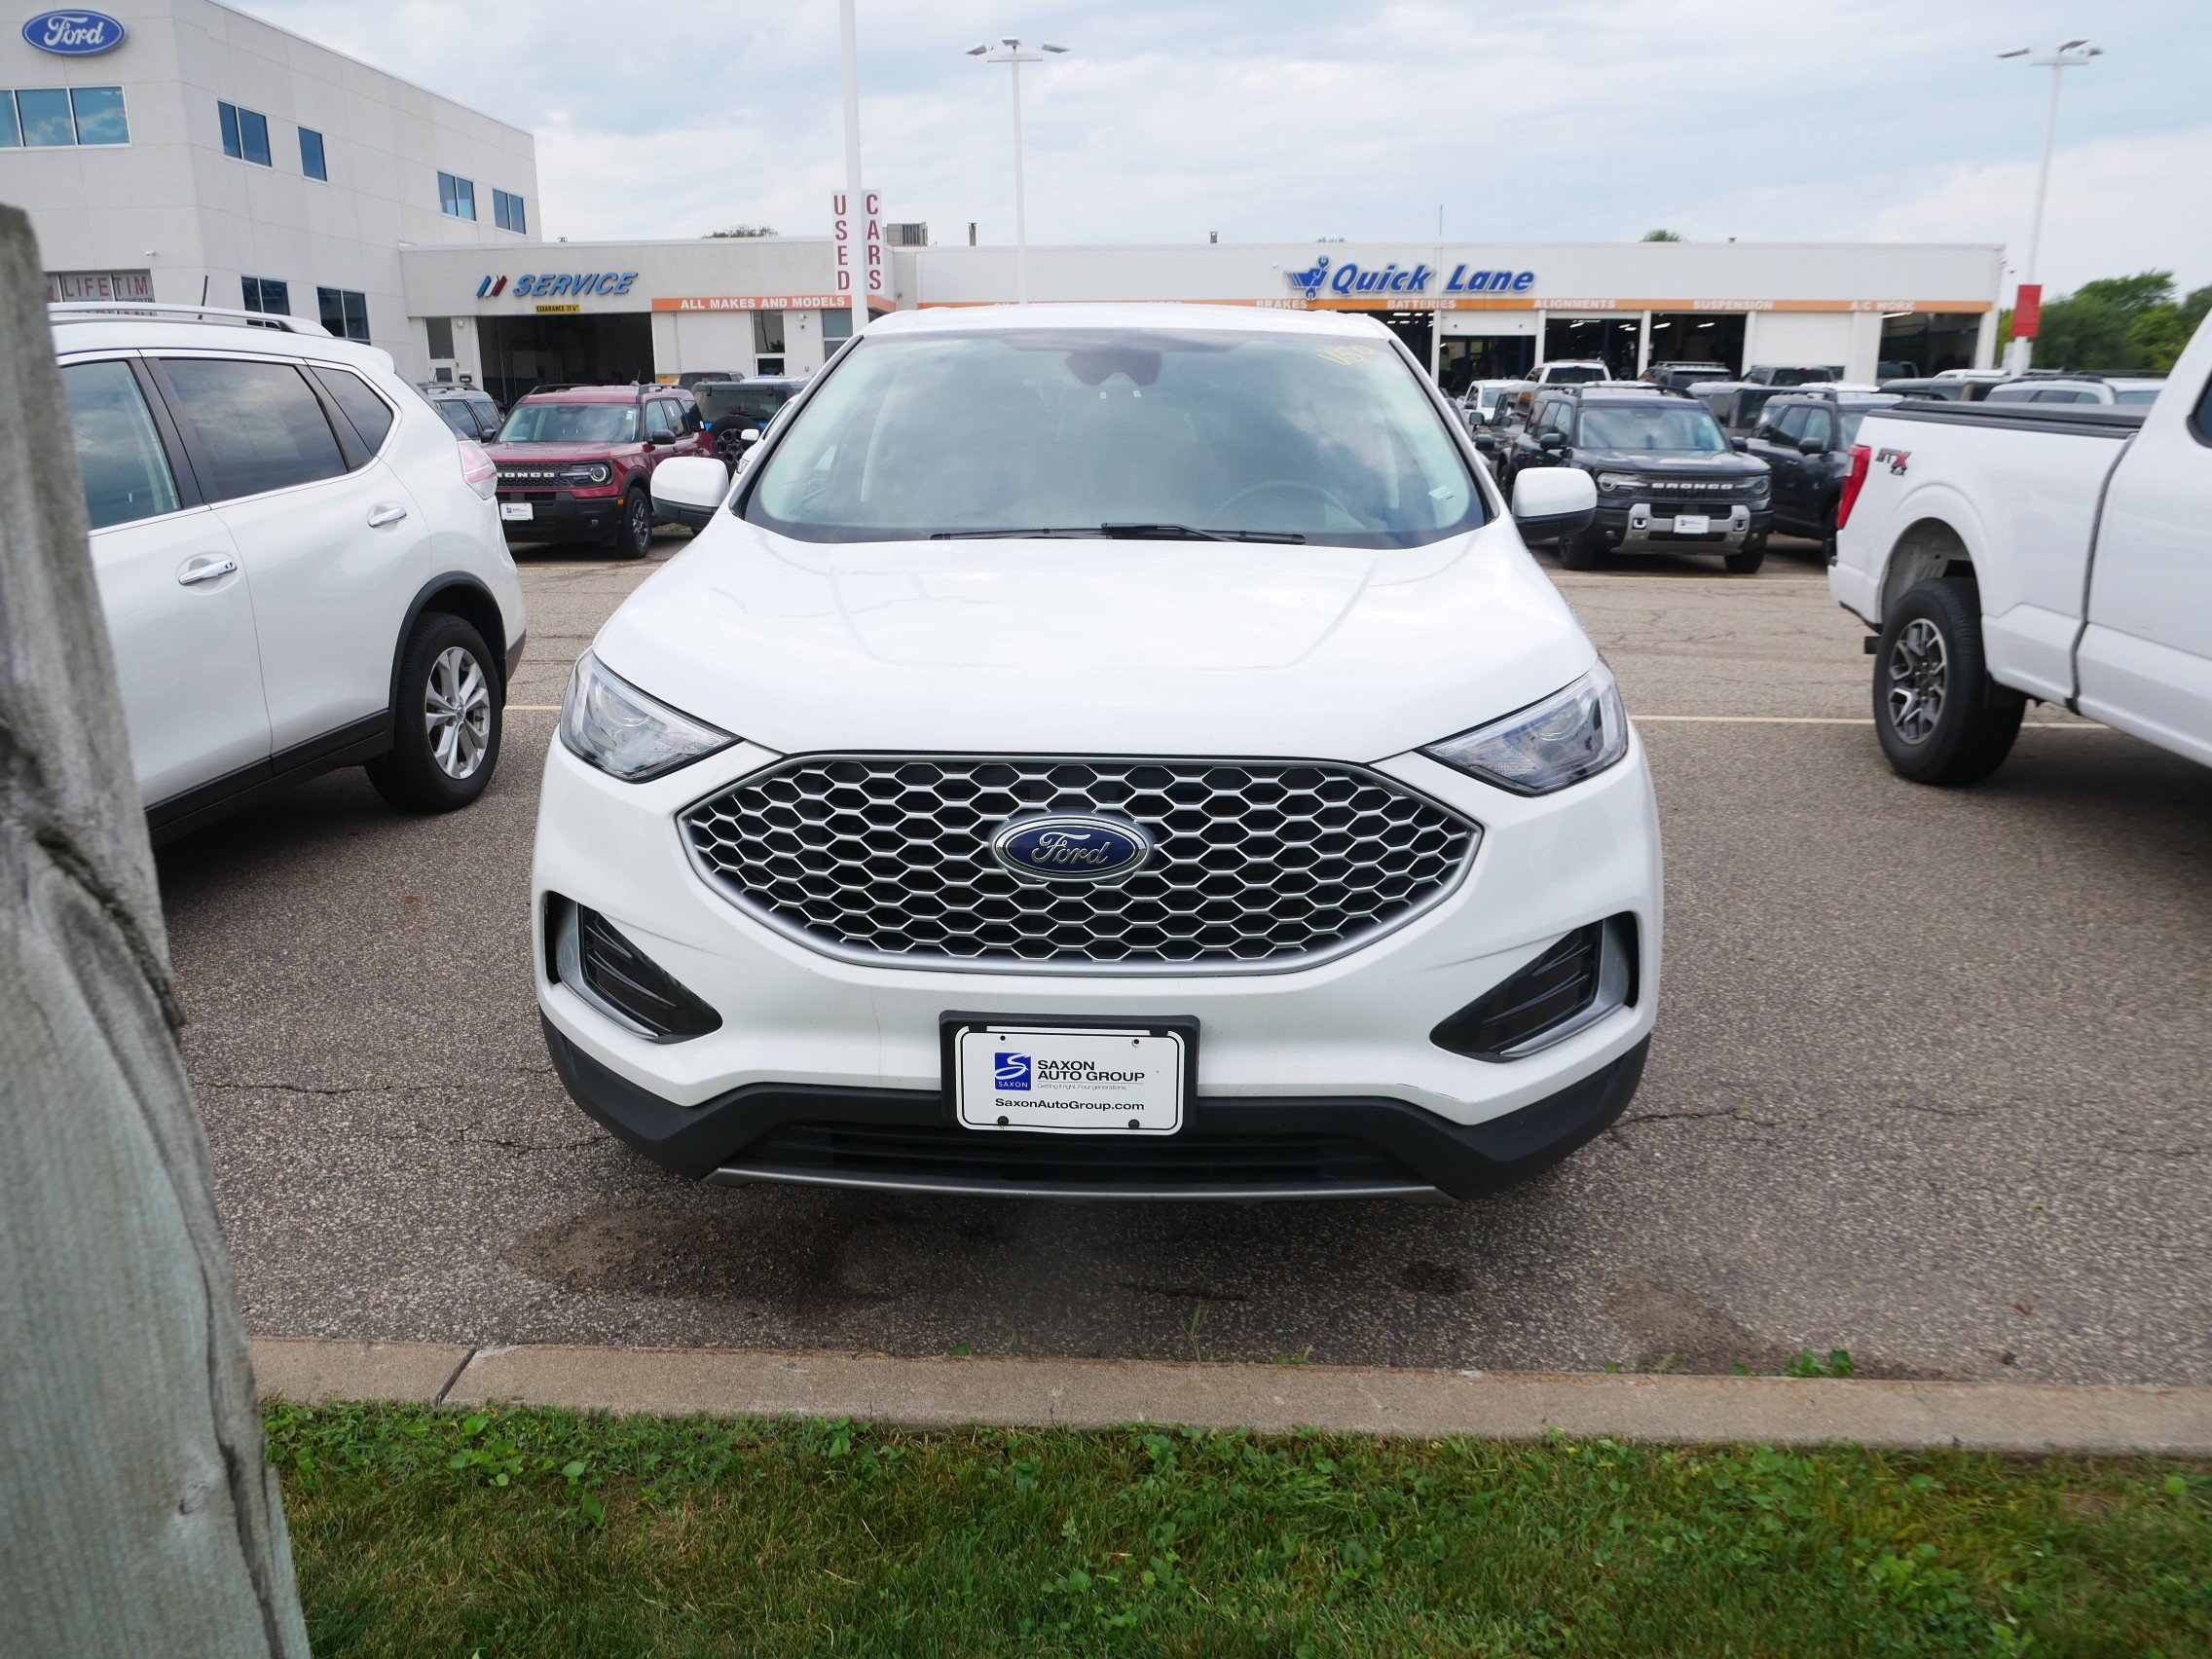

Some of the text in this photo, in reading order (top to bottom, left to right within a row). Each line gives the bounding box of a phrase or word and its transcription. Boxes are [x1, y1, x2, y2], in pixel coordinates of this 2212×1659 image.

[44, 16, 104, 47] Ford
[833, 194, 850, 291] USED
[866, 194, 882, 291] CARS
[513, 272, 639, 297] SERVICE
[1331, 263, 1536, 296] Quick Lane
[681, 296, 845, 310] ALL MAKES AND MODELS
[1256, 300, 1308, 309] BRAKES
[1387, 299, 1456, 309] BATTERIES
[1533, 299, 1615, 310] ALIGNMENTS
[1031, 831, 1111, 865] Ford
[1038, 1059, 1095, 1071] SAXON
[1038, 1071, 1145, 1082] AUTO GROUP
[995, 1098, 1145, 1112] SaxonAutoGroup.com
